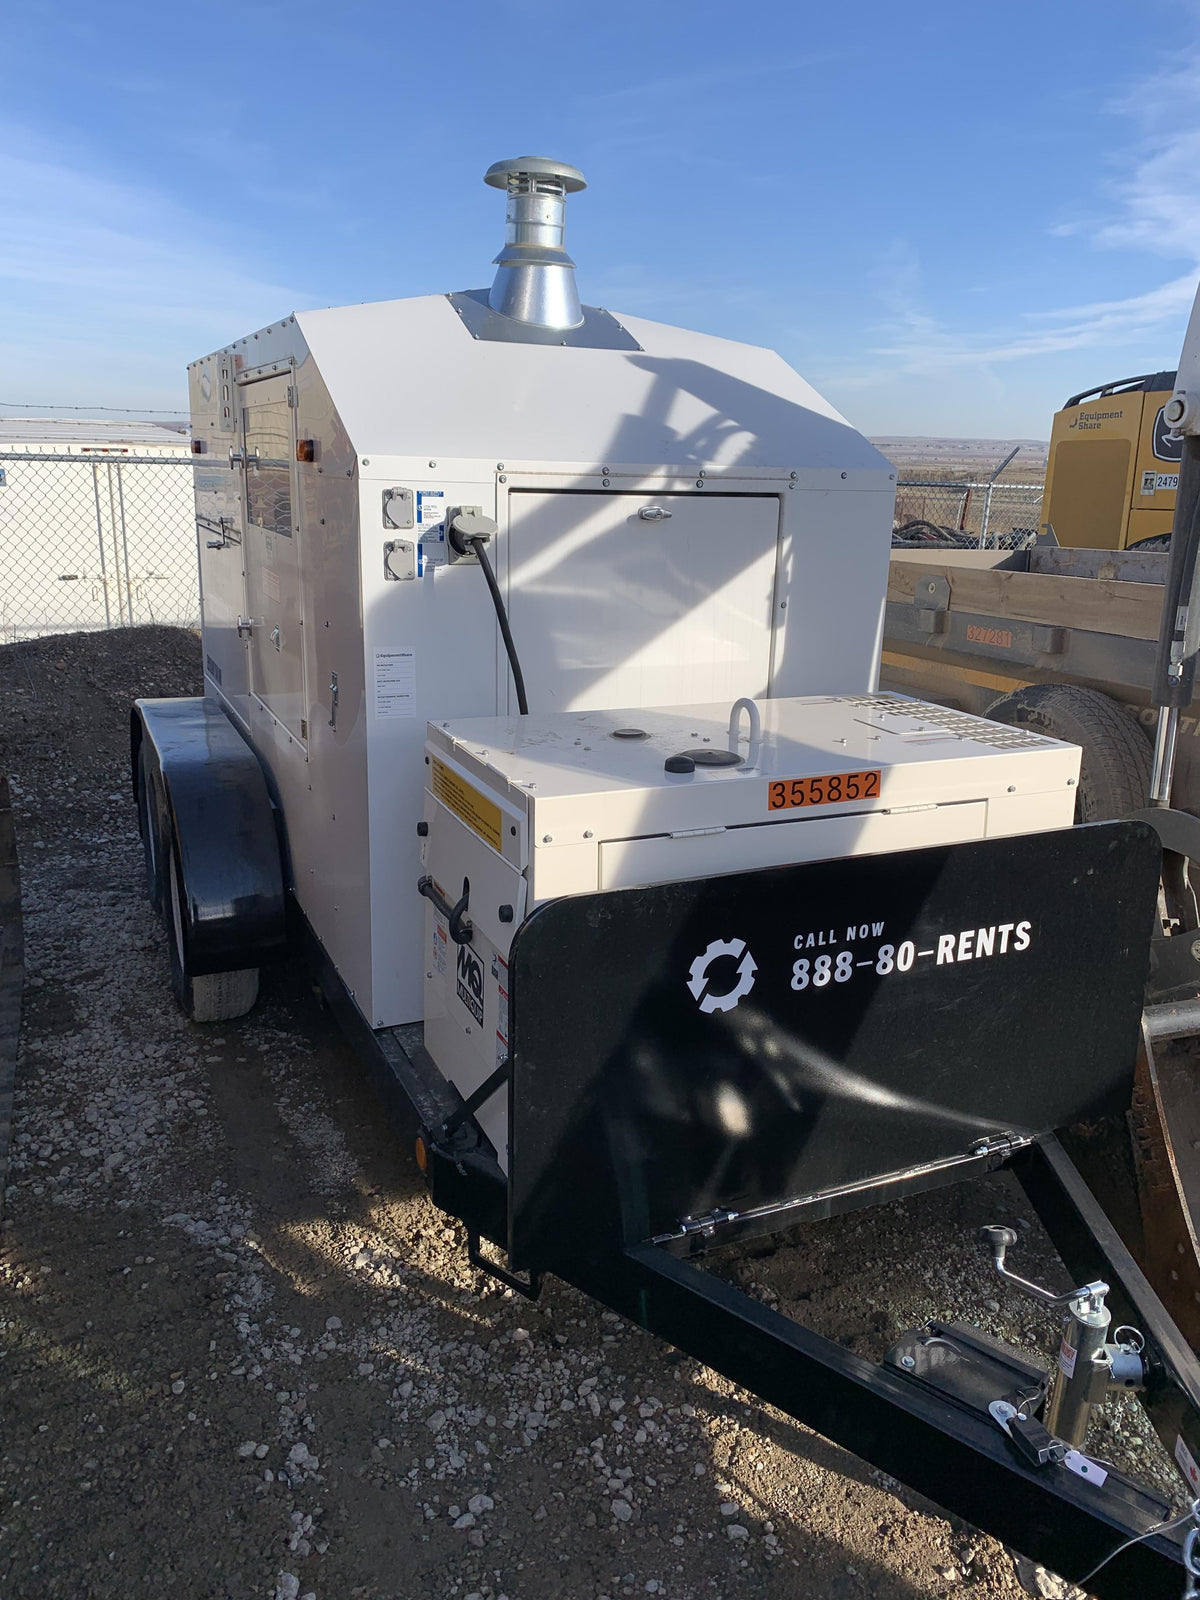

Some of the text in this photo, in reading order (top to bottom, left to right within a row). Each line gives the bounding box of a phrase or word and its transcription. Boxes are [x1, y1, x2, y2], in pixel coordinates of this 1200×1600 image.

[1078, 421, 1102, 430] Share
[1079, 410, 1123, 422] Equipment
[771, 772, 878, 809] 355852
[793, 921, 885, 950] CALL NOW
[790, 920, 1032, 991] 888-80-RENTS
